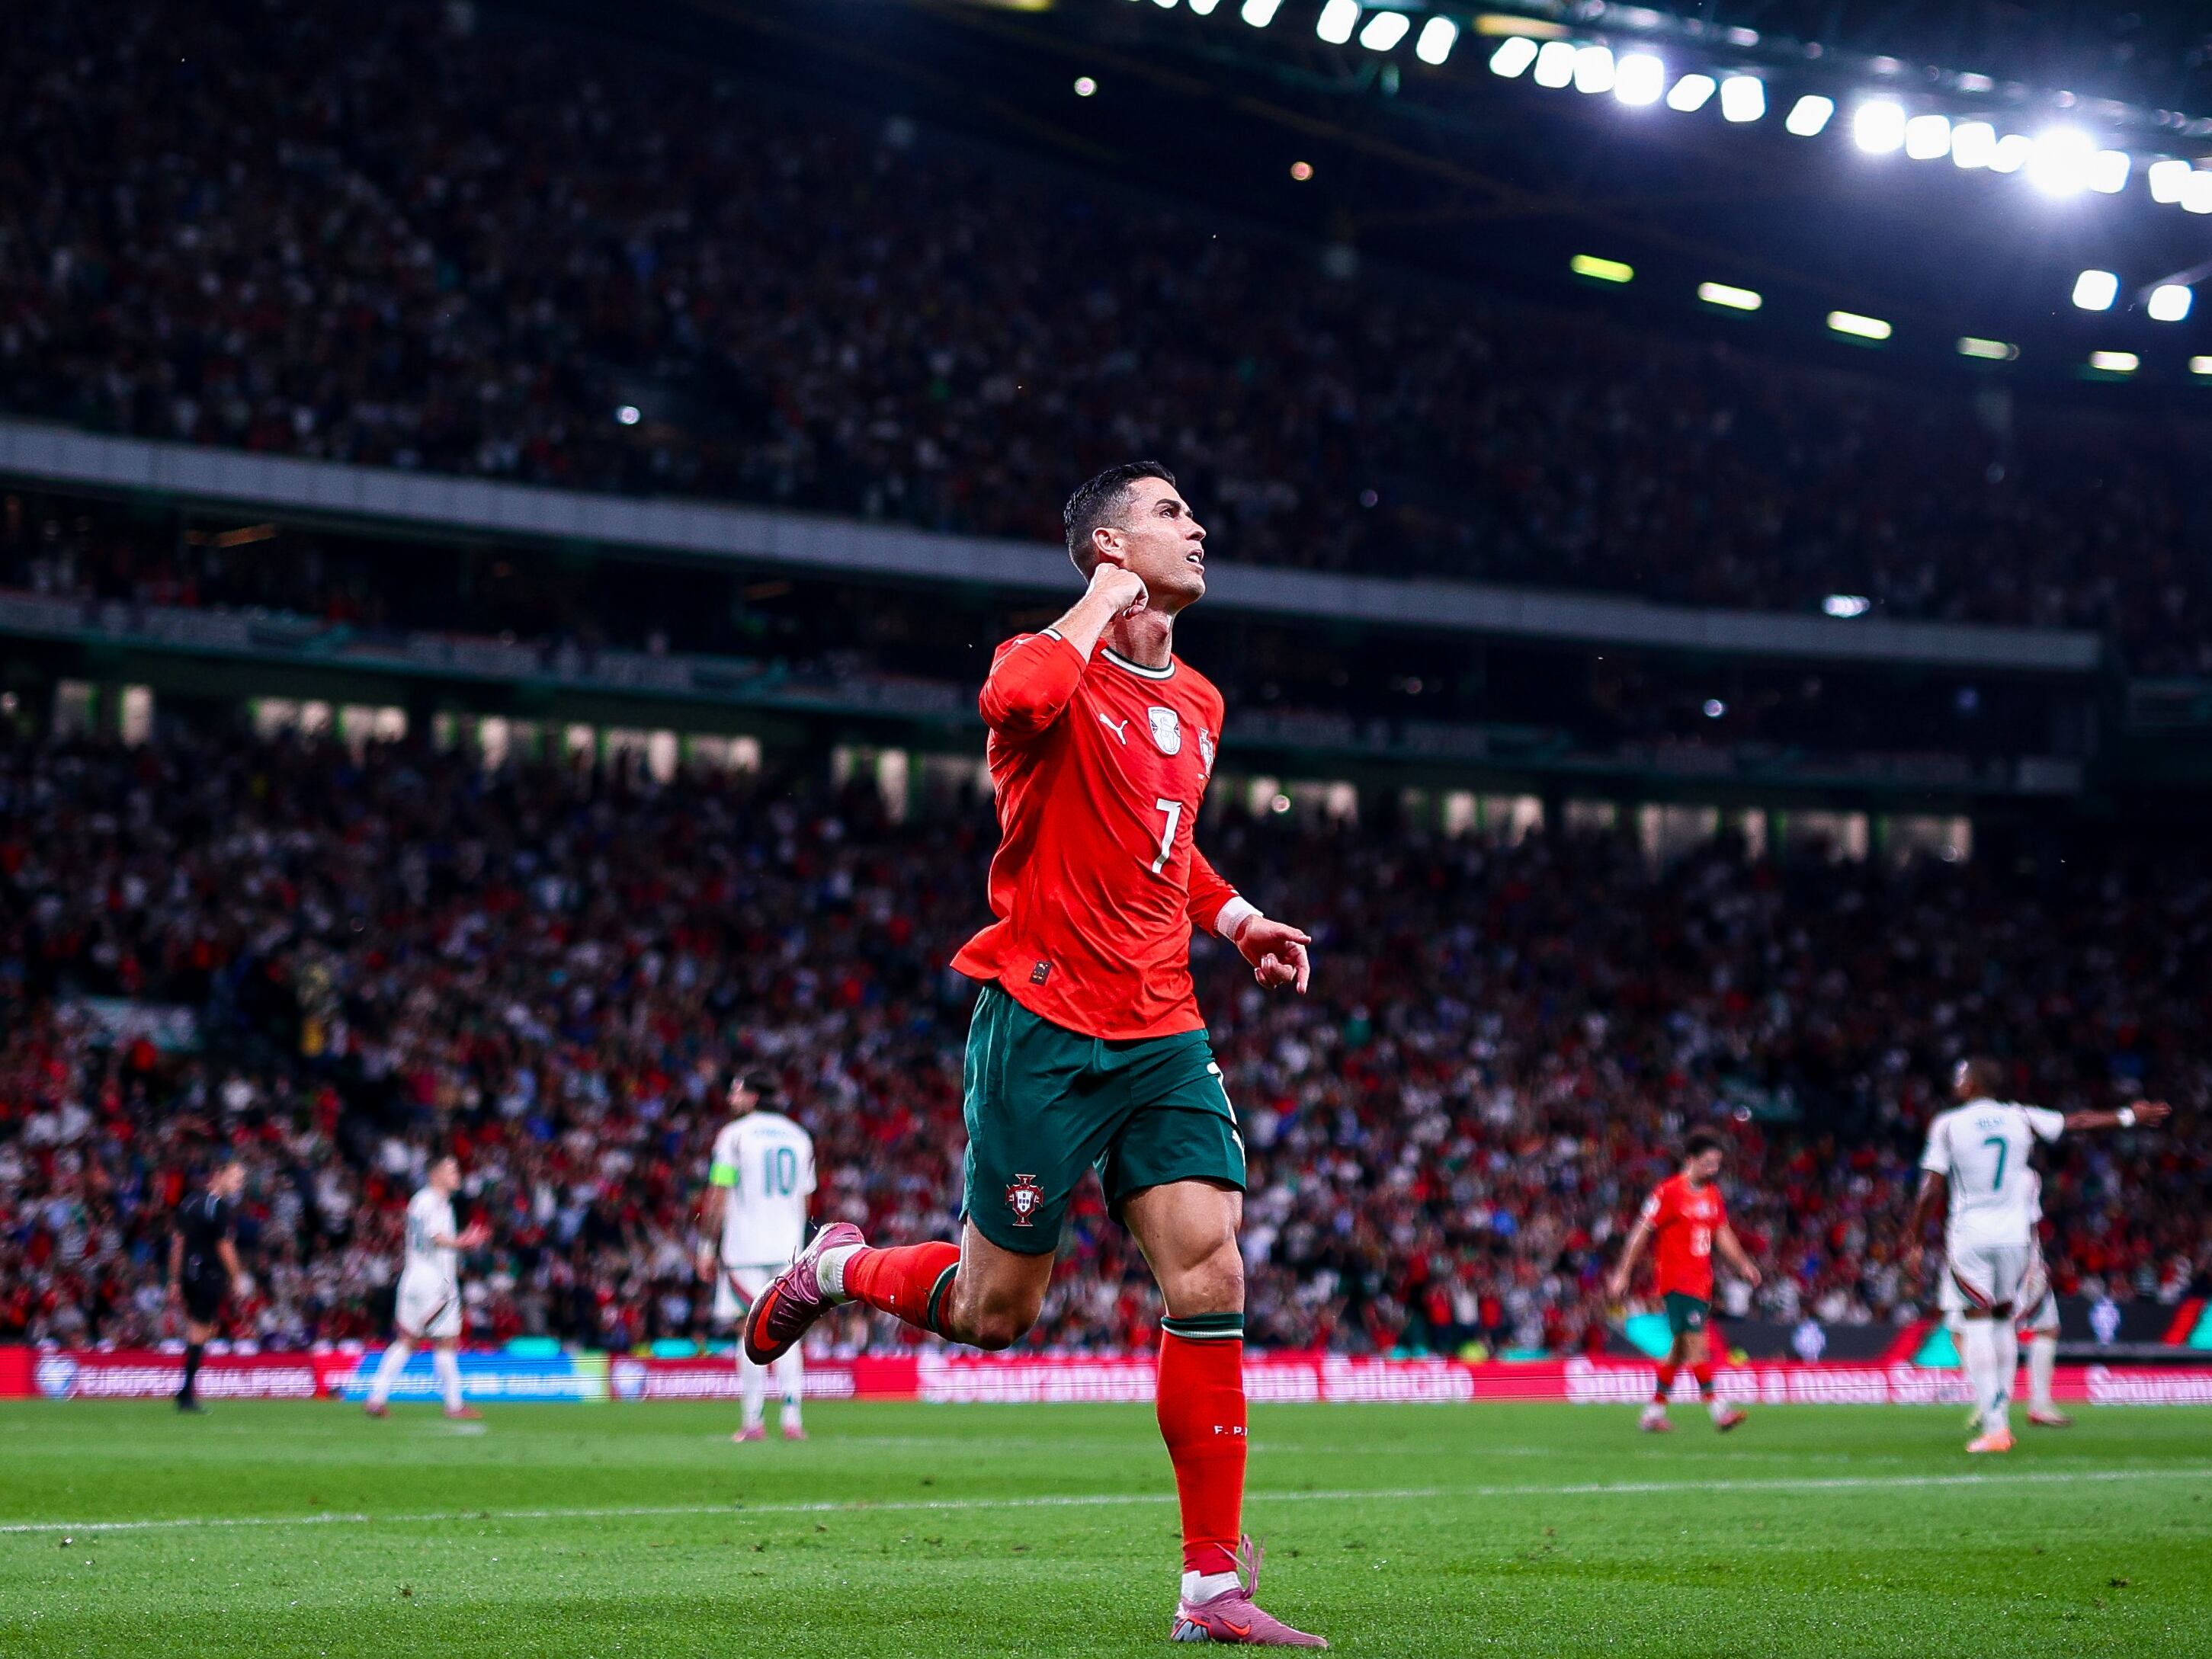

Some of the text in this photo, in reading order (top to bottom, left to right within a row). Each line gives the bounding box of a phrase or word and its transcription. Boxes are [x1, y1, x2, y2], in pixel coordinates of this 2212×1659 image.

[1152, 798, 1182, 874] 7
[763, 1145, 797, 1198] 10
[1983, 1135, 2008, 1191] 7
